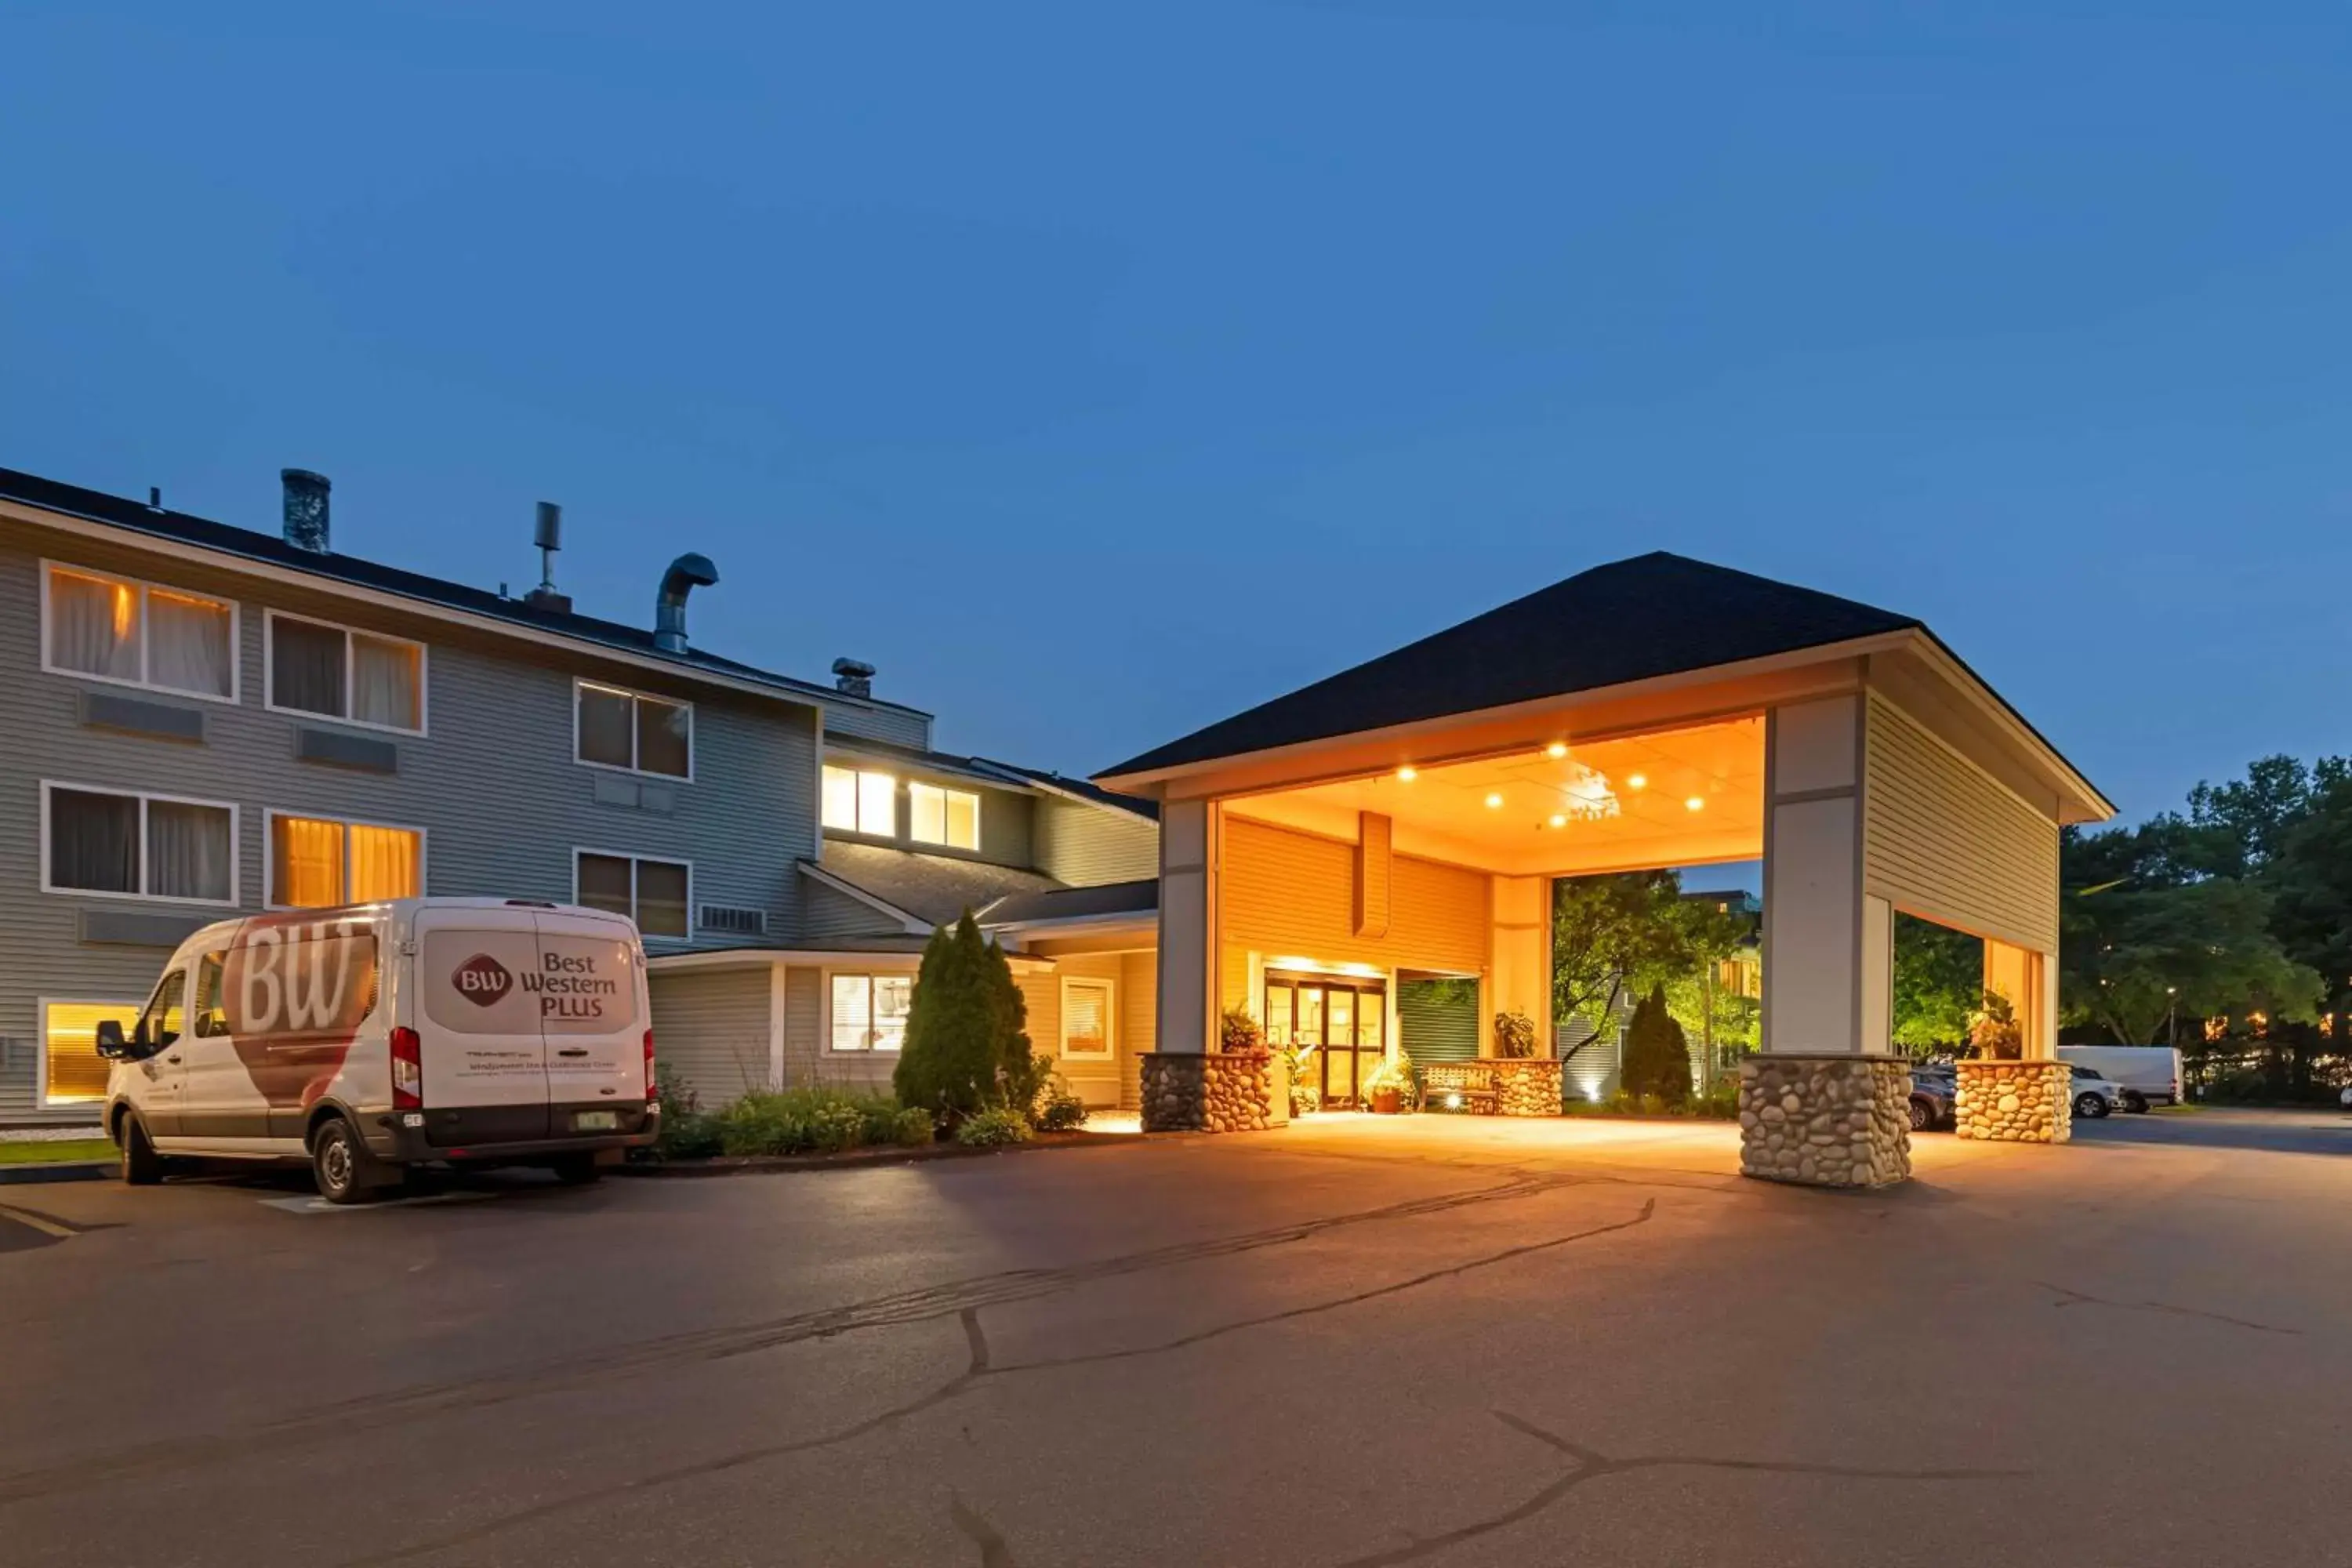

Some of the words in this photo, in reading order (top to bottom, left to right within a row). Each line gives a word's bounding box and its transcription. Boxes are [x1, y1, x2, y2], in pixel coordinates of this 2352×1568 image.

[544, 953, 596, 974] Best
[241, 921, 352, 1033] BW
[461, 971, 506, 992] BW
[521, 972, 616, 995] Western
[542, 997, 603, 1018] PLUS
